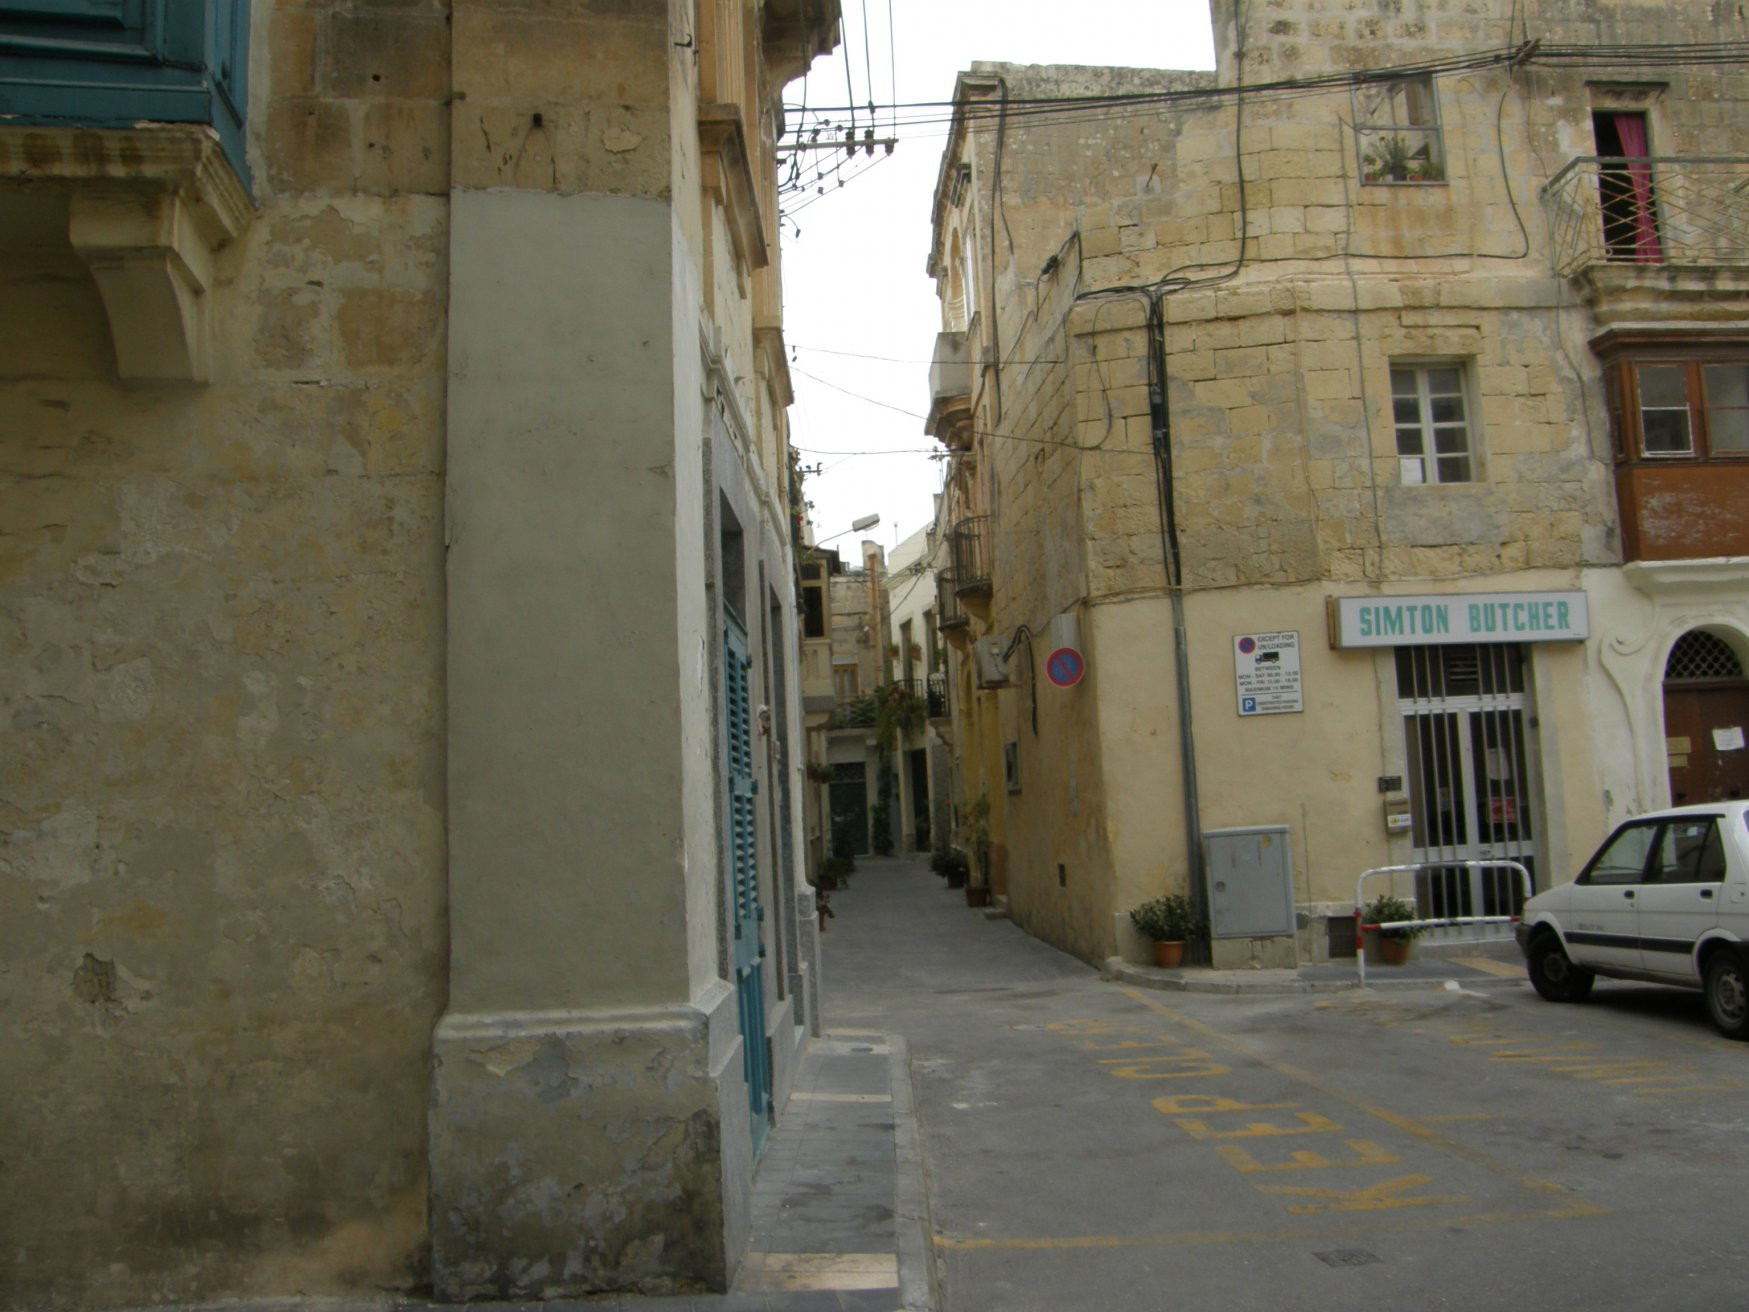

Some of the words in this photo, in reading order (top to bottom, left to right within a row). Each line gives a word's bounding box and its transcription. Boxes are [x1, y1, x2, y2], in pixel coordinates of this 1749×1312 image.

[1359, 604, 1450, 637] SIMTON
[1468, 600, 1571, 633] BUTCHER
[1150, 1094, 1475, 1215] KEEP
